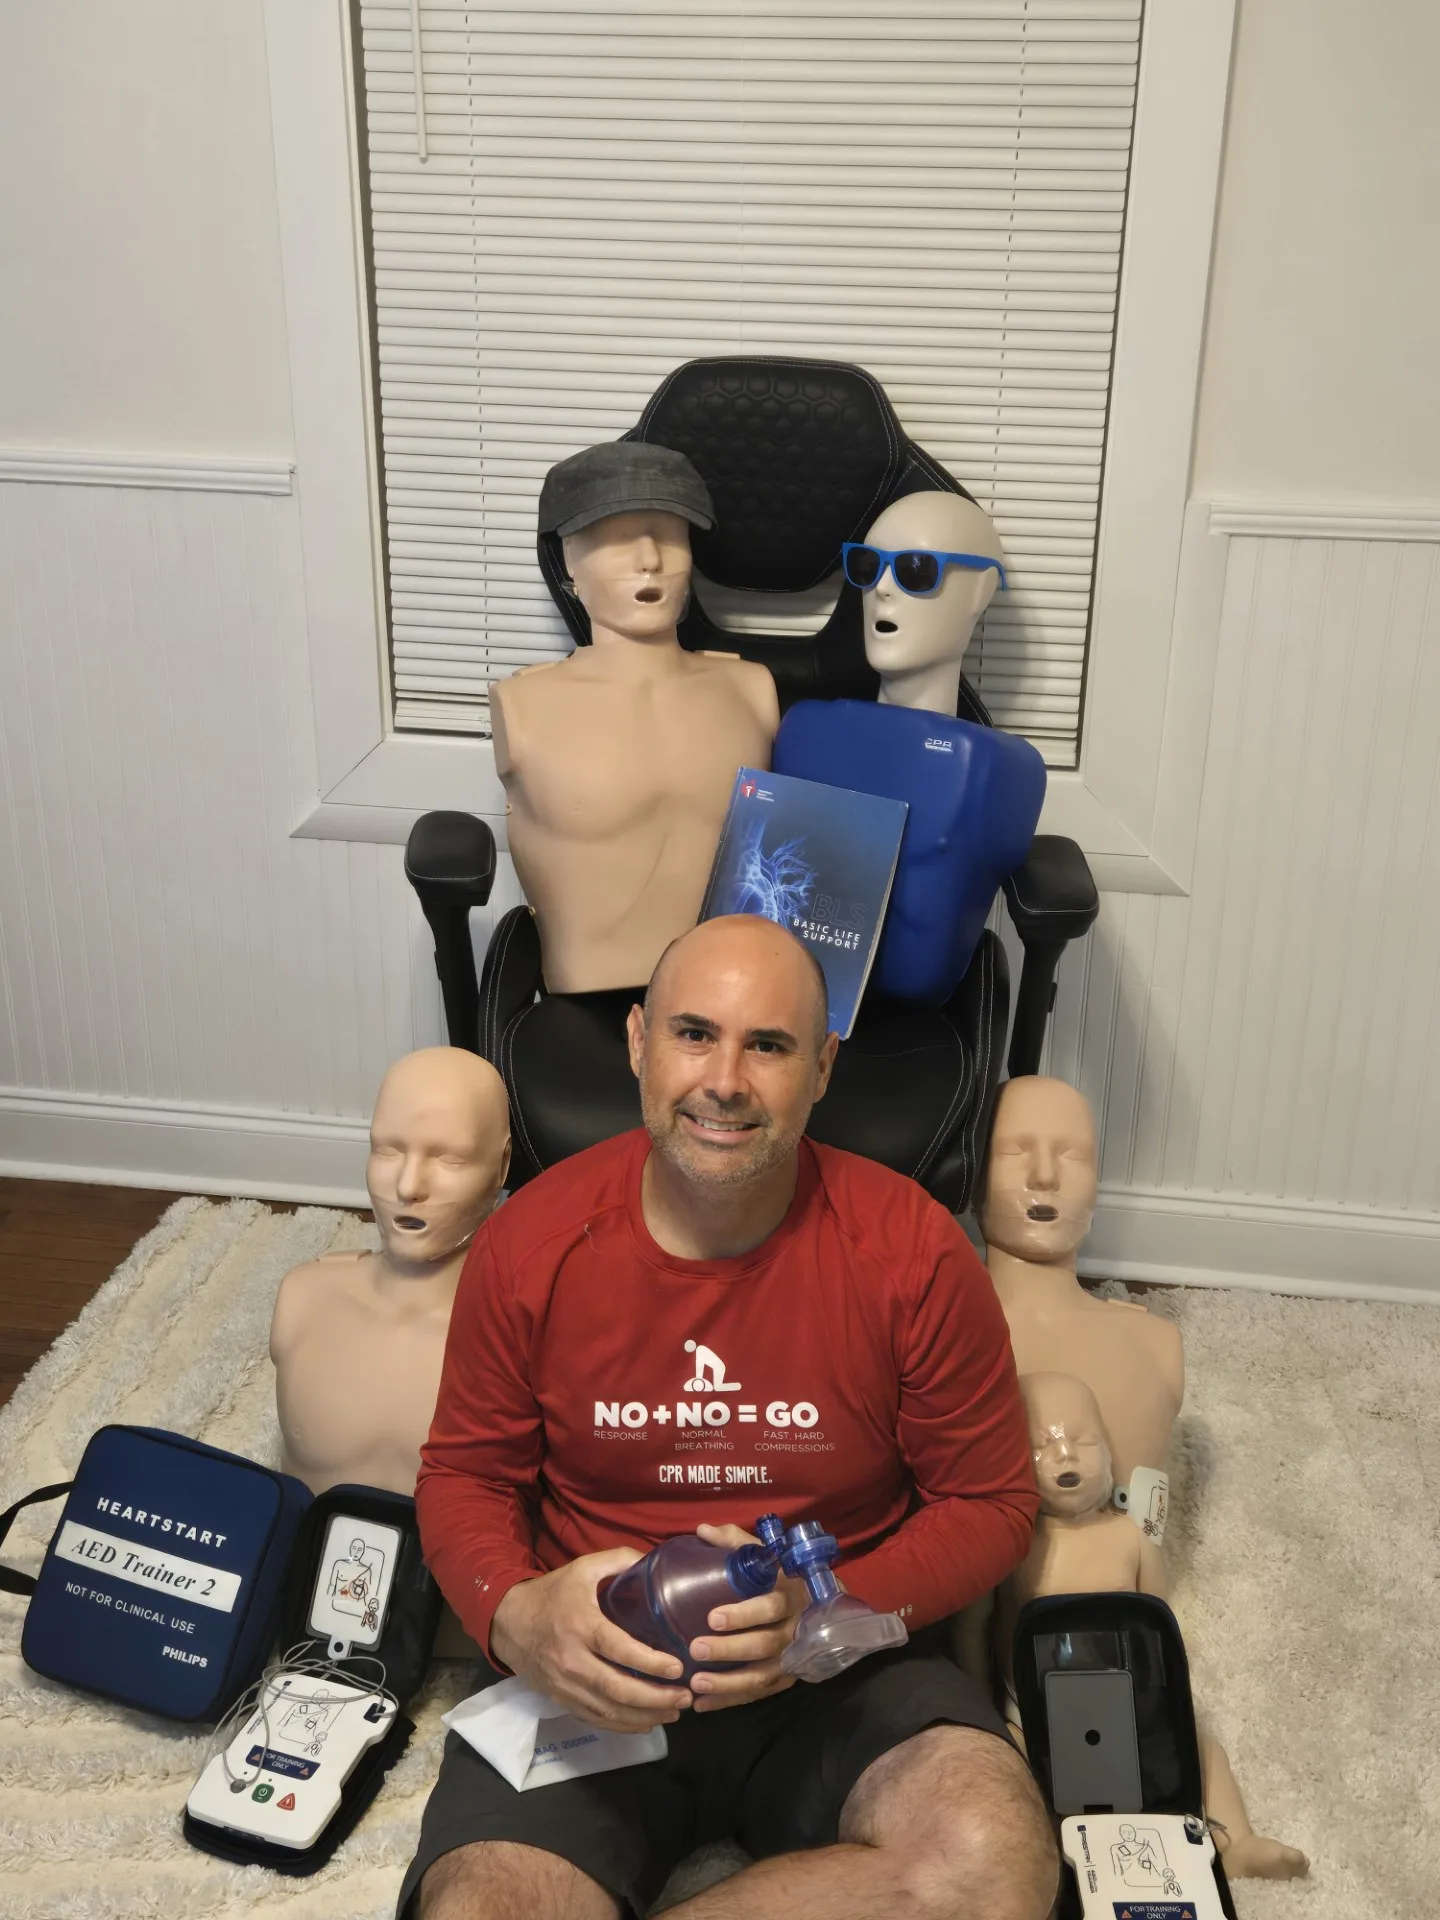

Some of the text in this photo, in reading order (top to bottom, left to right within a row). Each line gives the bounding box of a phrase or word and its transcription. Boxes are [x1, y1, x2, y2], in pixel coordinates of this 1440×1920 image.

[811, 893, 868, 930] BLS
[793, 918, 861, 942] BASIC LIFE
[803, 930, 859, 950] SUPPORT
[594, 1401, 648, 1428] NO
[676, 1401, 731, 1428] NO
[765, 1400, 819, 1428] GO
[593, 1430, 648, 1441] RESPONSE
[681, 1429, 727, 1439] NORMAL
[794, 1431, 825, 1441] HARD
[674, 1441, 734, 1451] BREATHING
[754, 1442, 836, 1453] COMPRESSIONS
[659, 1465, 684, 1483] CPR
[688, 1465, 721, 1484] MADE
[96, 1496, 228, 1549] HEARTSTART
[71, 1536, 217, 1597] AED Trainer 2
[65, 1581, 196, 1634] NOT FOR CLINICAL USE
[162, 1645, 208, 1668] PHILIPS
[271, 1760, 290, 1770] ONLY
[276, 1755, 307, 1768] TRAINING
[1145, 1905, 1181, 1913] TRAINING
